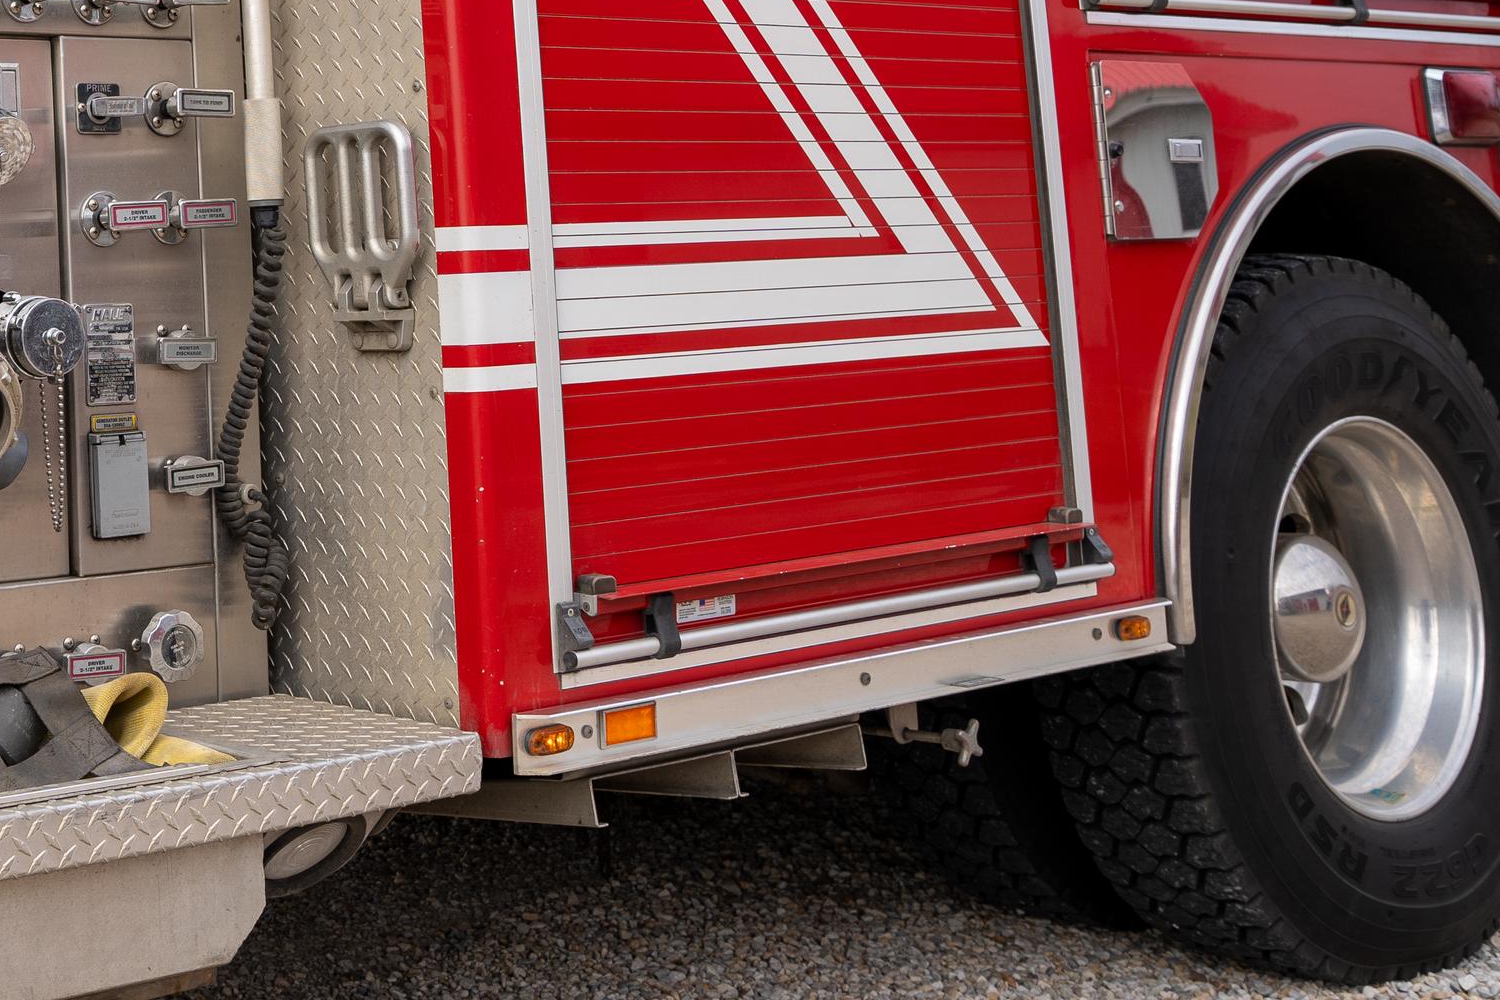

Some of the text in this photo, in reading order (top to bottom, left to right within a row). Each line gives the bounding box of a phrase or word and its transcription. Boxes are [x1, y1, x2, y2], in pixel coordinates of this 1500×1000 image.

[86, 84, 112, 93] PRIME
[92, 308, 125, 320] HALE
[1289, 780, 1368, 882] RSD
